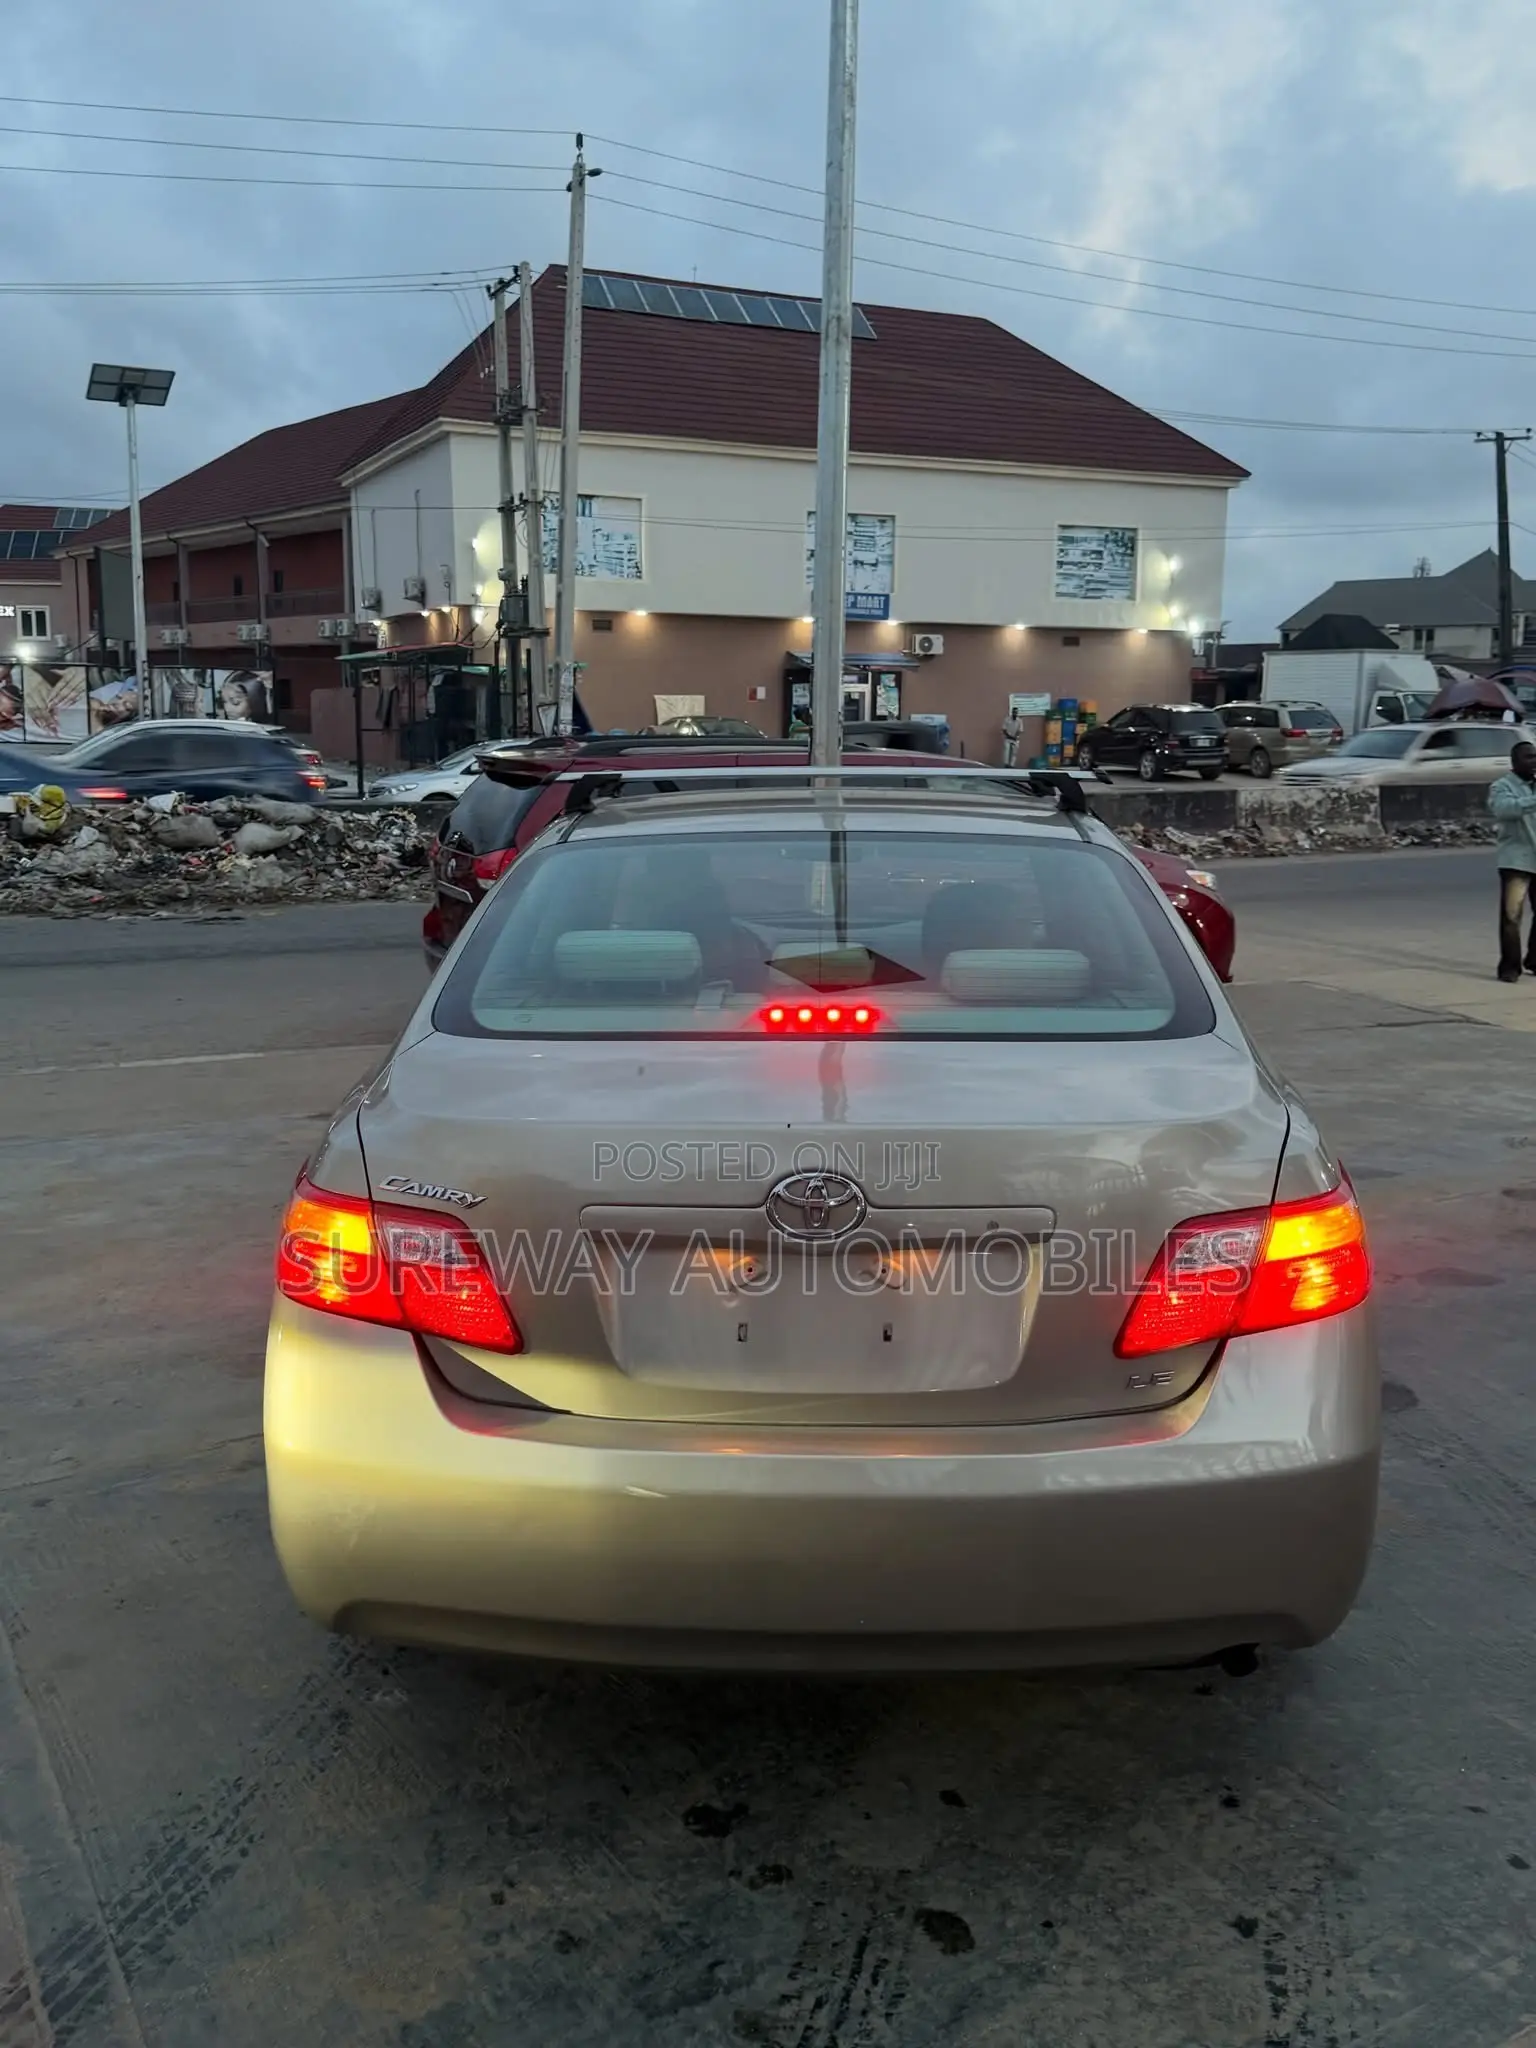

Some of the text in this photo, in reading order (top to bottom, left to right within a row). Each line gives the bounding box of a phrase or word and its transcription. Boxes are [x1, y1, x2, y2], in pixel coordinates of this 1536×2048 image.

[856, 595, 886, 609] MART
[378, 1175, 488, 1209] CAMRY
[1125, 1370, 1176, 1389] LE
